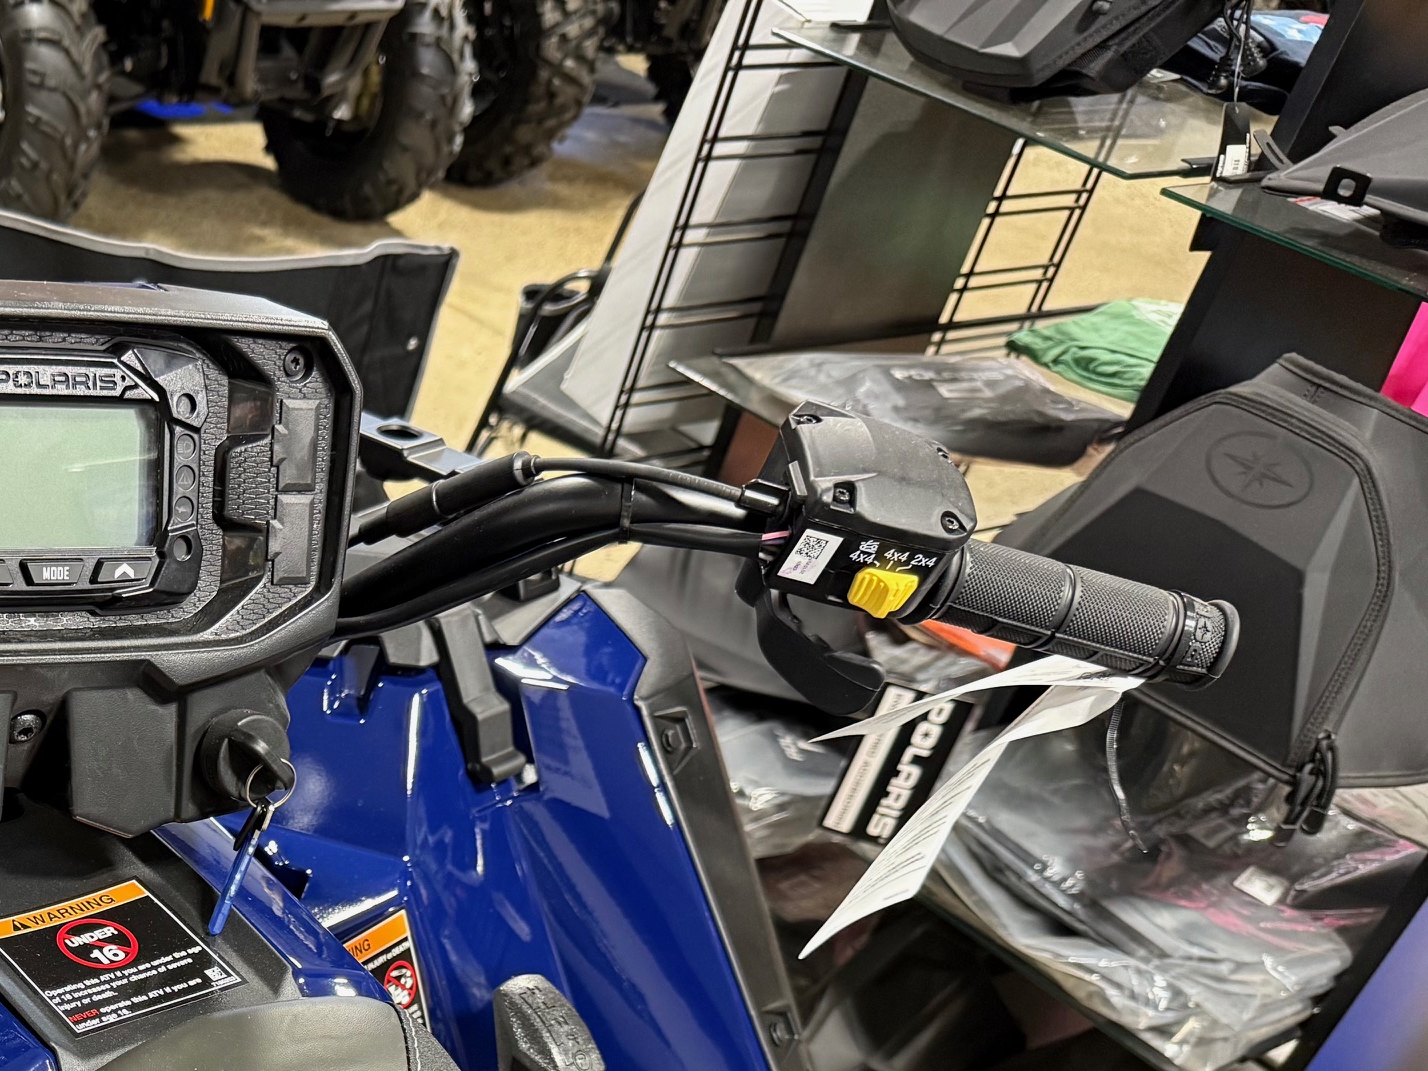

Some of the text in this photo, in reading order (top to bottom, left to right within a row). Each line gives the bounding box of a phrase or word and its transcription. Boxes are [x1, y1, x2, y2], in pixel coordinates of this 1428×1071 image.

[849, 549, 937, 568] 4x4 4x4 2x4
[42, 566, 70, 580] MODE
[866, 694, 956, 838] POLARIS
[26, 894, 116, 926] WARNING
[64, 926, 119, 948] UNDER
[89, 944, 126, 965] 16
[67, 1008, 100, 1023] NEVER
